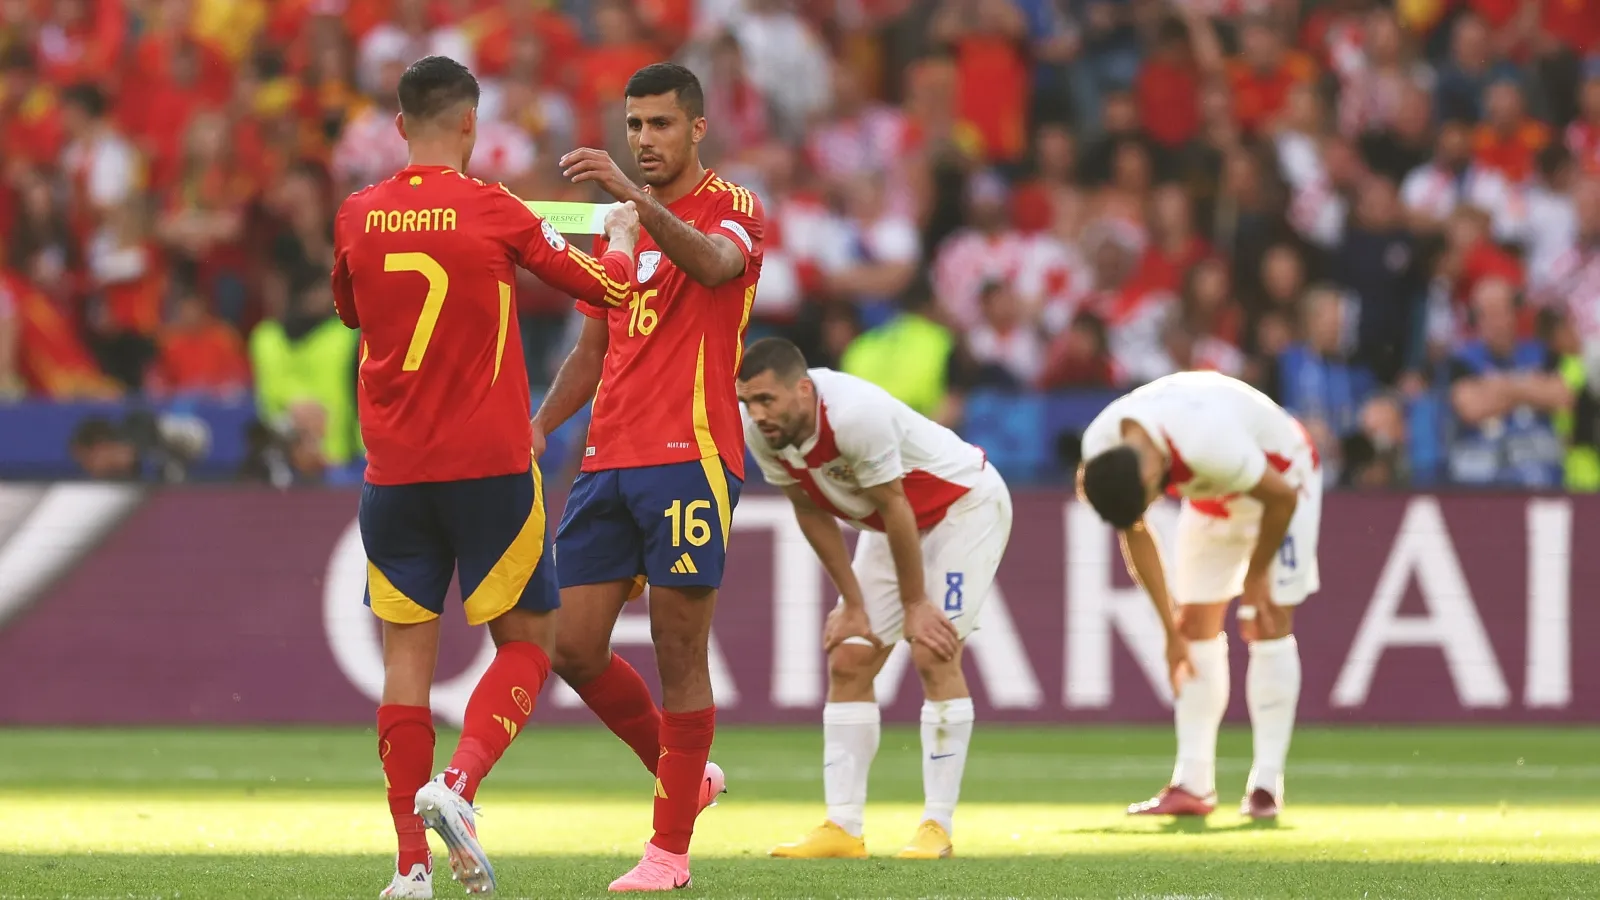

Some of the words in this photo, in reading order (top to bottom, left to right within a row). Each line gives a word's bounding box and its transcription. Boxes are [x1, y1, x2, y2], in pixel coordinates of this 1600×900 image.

[365, 208, 457, 233] MORATA
[384, 252, 449, 371] 7
[628, 289, 658, 337] 16
[664, 499, 711, 547] 16
[944, 572, 964, 611] 8
